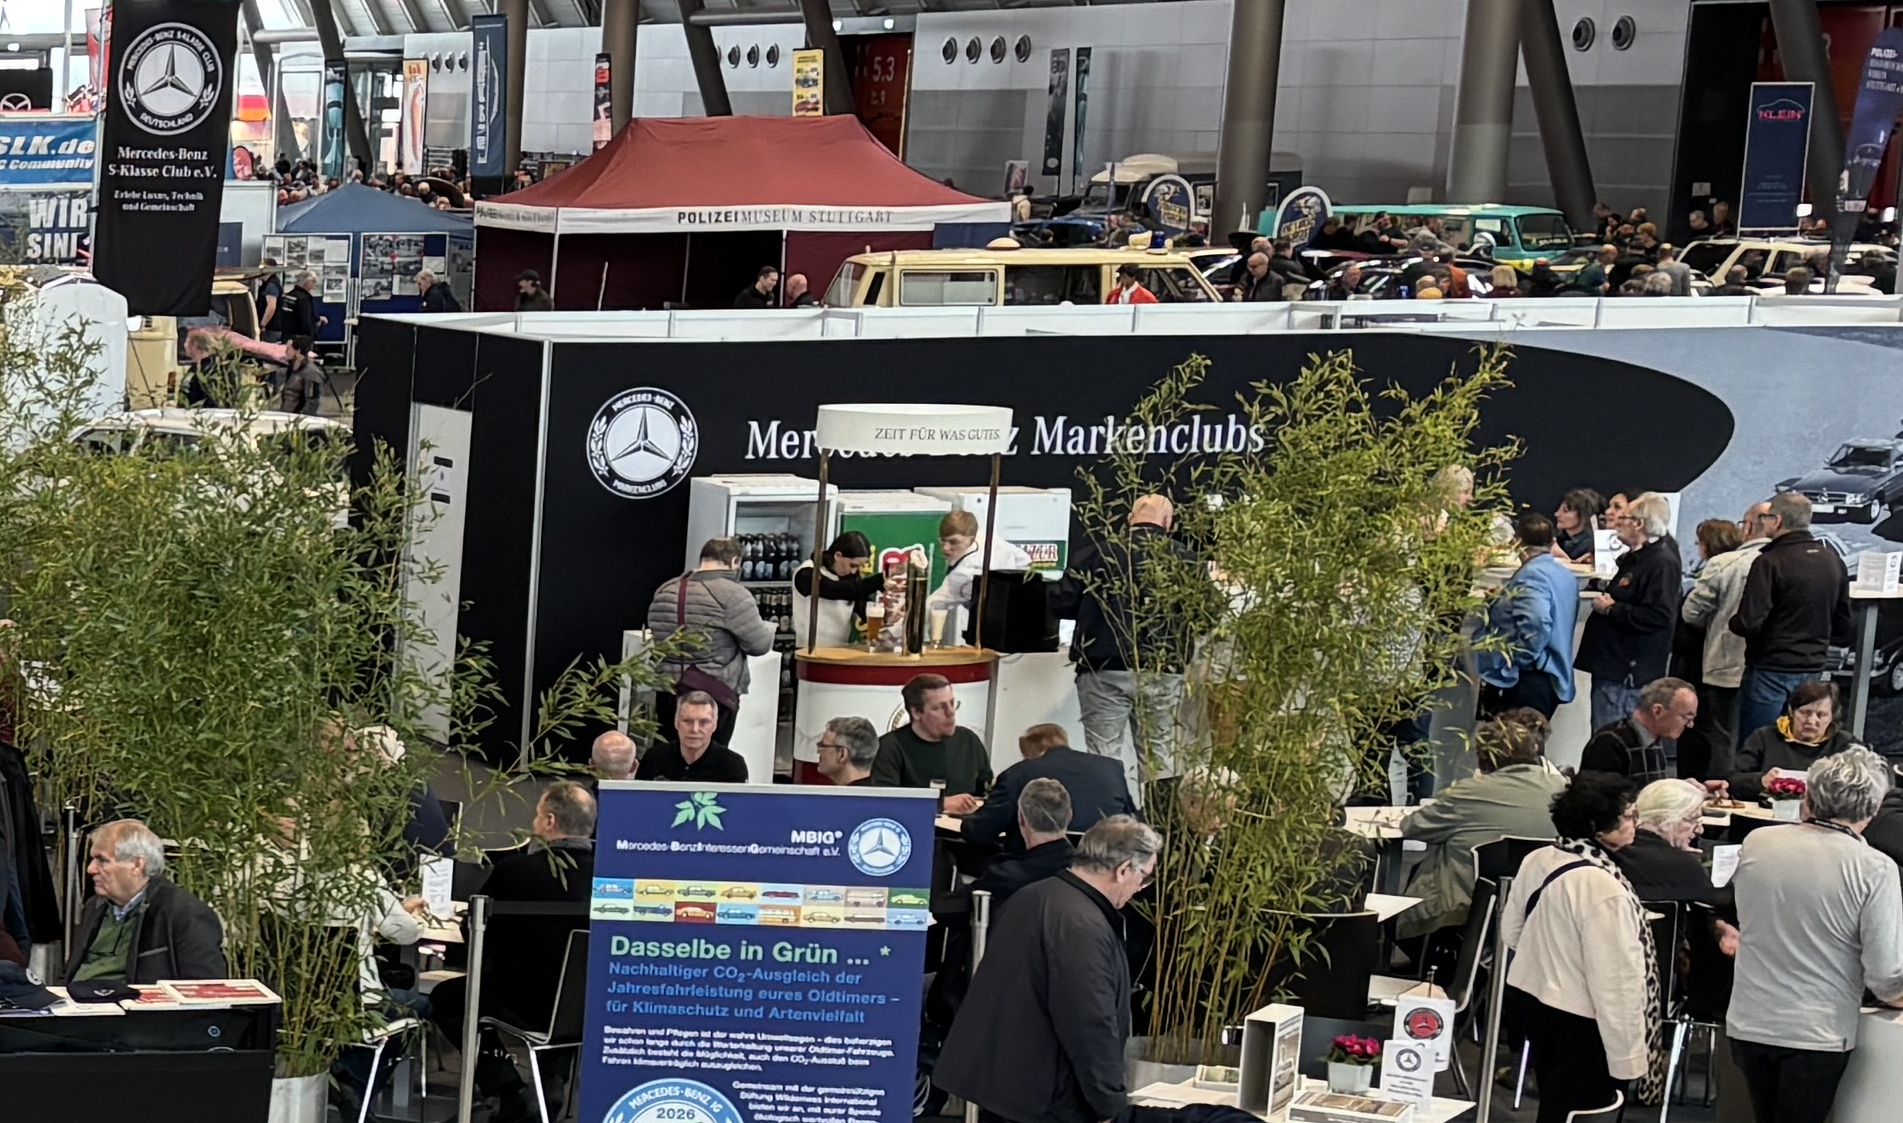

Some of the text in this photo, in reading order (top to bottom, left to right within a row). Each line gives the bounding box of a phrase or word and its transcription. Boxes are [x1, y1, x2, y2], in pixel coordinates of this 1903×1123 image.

[873, 56, 895, 82] 5.3
[118, 146, 208, 160] Mercedes-Benz
[9, 159, 94, 170] Community
[108, 164, 217, 178] S-Klasse Club e.V.
[29, 199, 88, 228] WIR
[808, 211, 894, 224] STUTTGART
[875, 427, 906, 441] ZEIT
[909, 426, 936, 441] FÜR
[940, 428, 966, 442] WAS
[1032, 414, 1266, 456] Markenclubs
[611, 936, 732, 960] Dasselbe
[741, 941, 763, 961] in
[773, 941, 837, 963] Grün
[609, 962, 708, 979] Nachhaltiger
[835, 970, 862, 984] der
[608, 981, 886, 1004] Jahresfahrleistung eures Oldtimers
[607, 1001, 865, 1023] für Klimaschutz und Artenvielfalt
[648, 1028, 665, 1036] und
[666, 1028, 699, 1038] Pflegen
[628, 1086, 711, 1108] MERCEDES-BENZ
[656, 1108, 696, 1120] 2026
